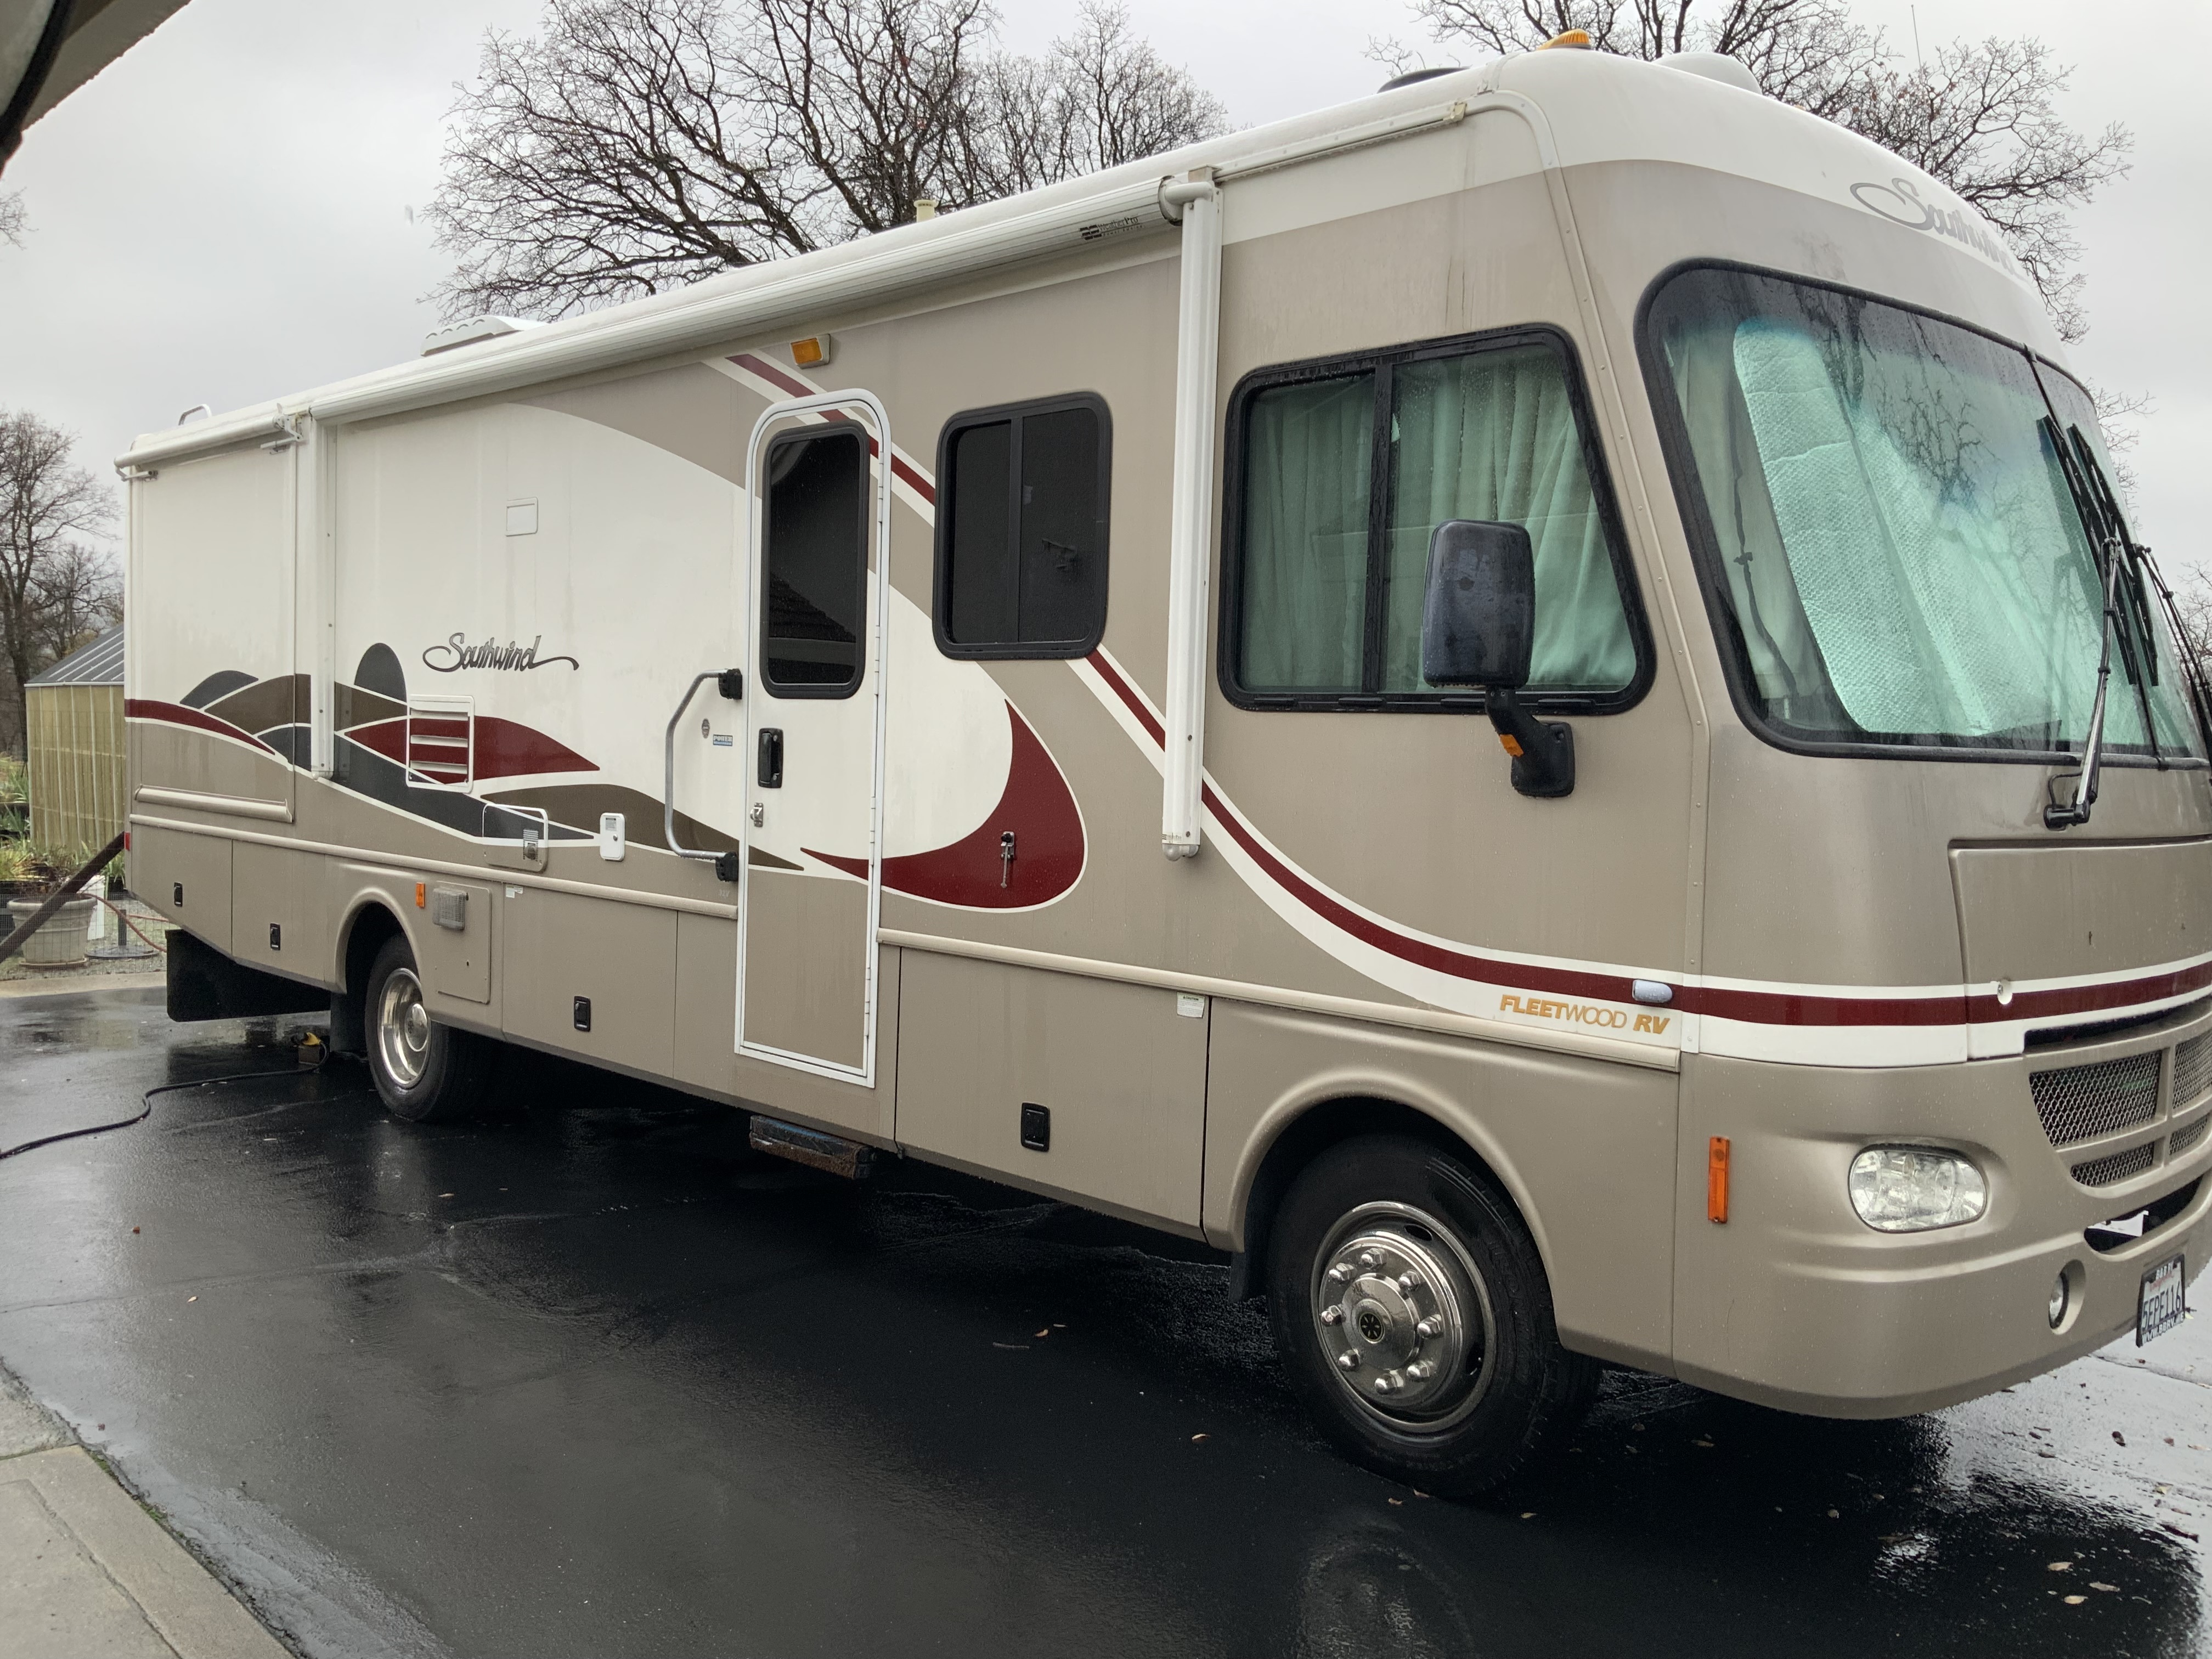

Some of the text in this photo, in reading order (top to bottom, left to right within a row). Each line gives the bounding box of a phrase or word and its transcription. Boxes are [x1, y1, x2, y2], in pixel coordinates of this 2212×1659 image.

[422, 632, 579, 673] Southwind
[1499, 994, 1671, 1034] FLEETWOOD RV
[2142, 1280, 2181, 1331] 5EPE116
